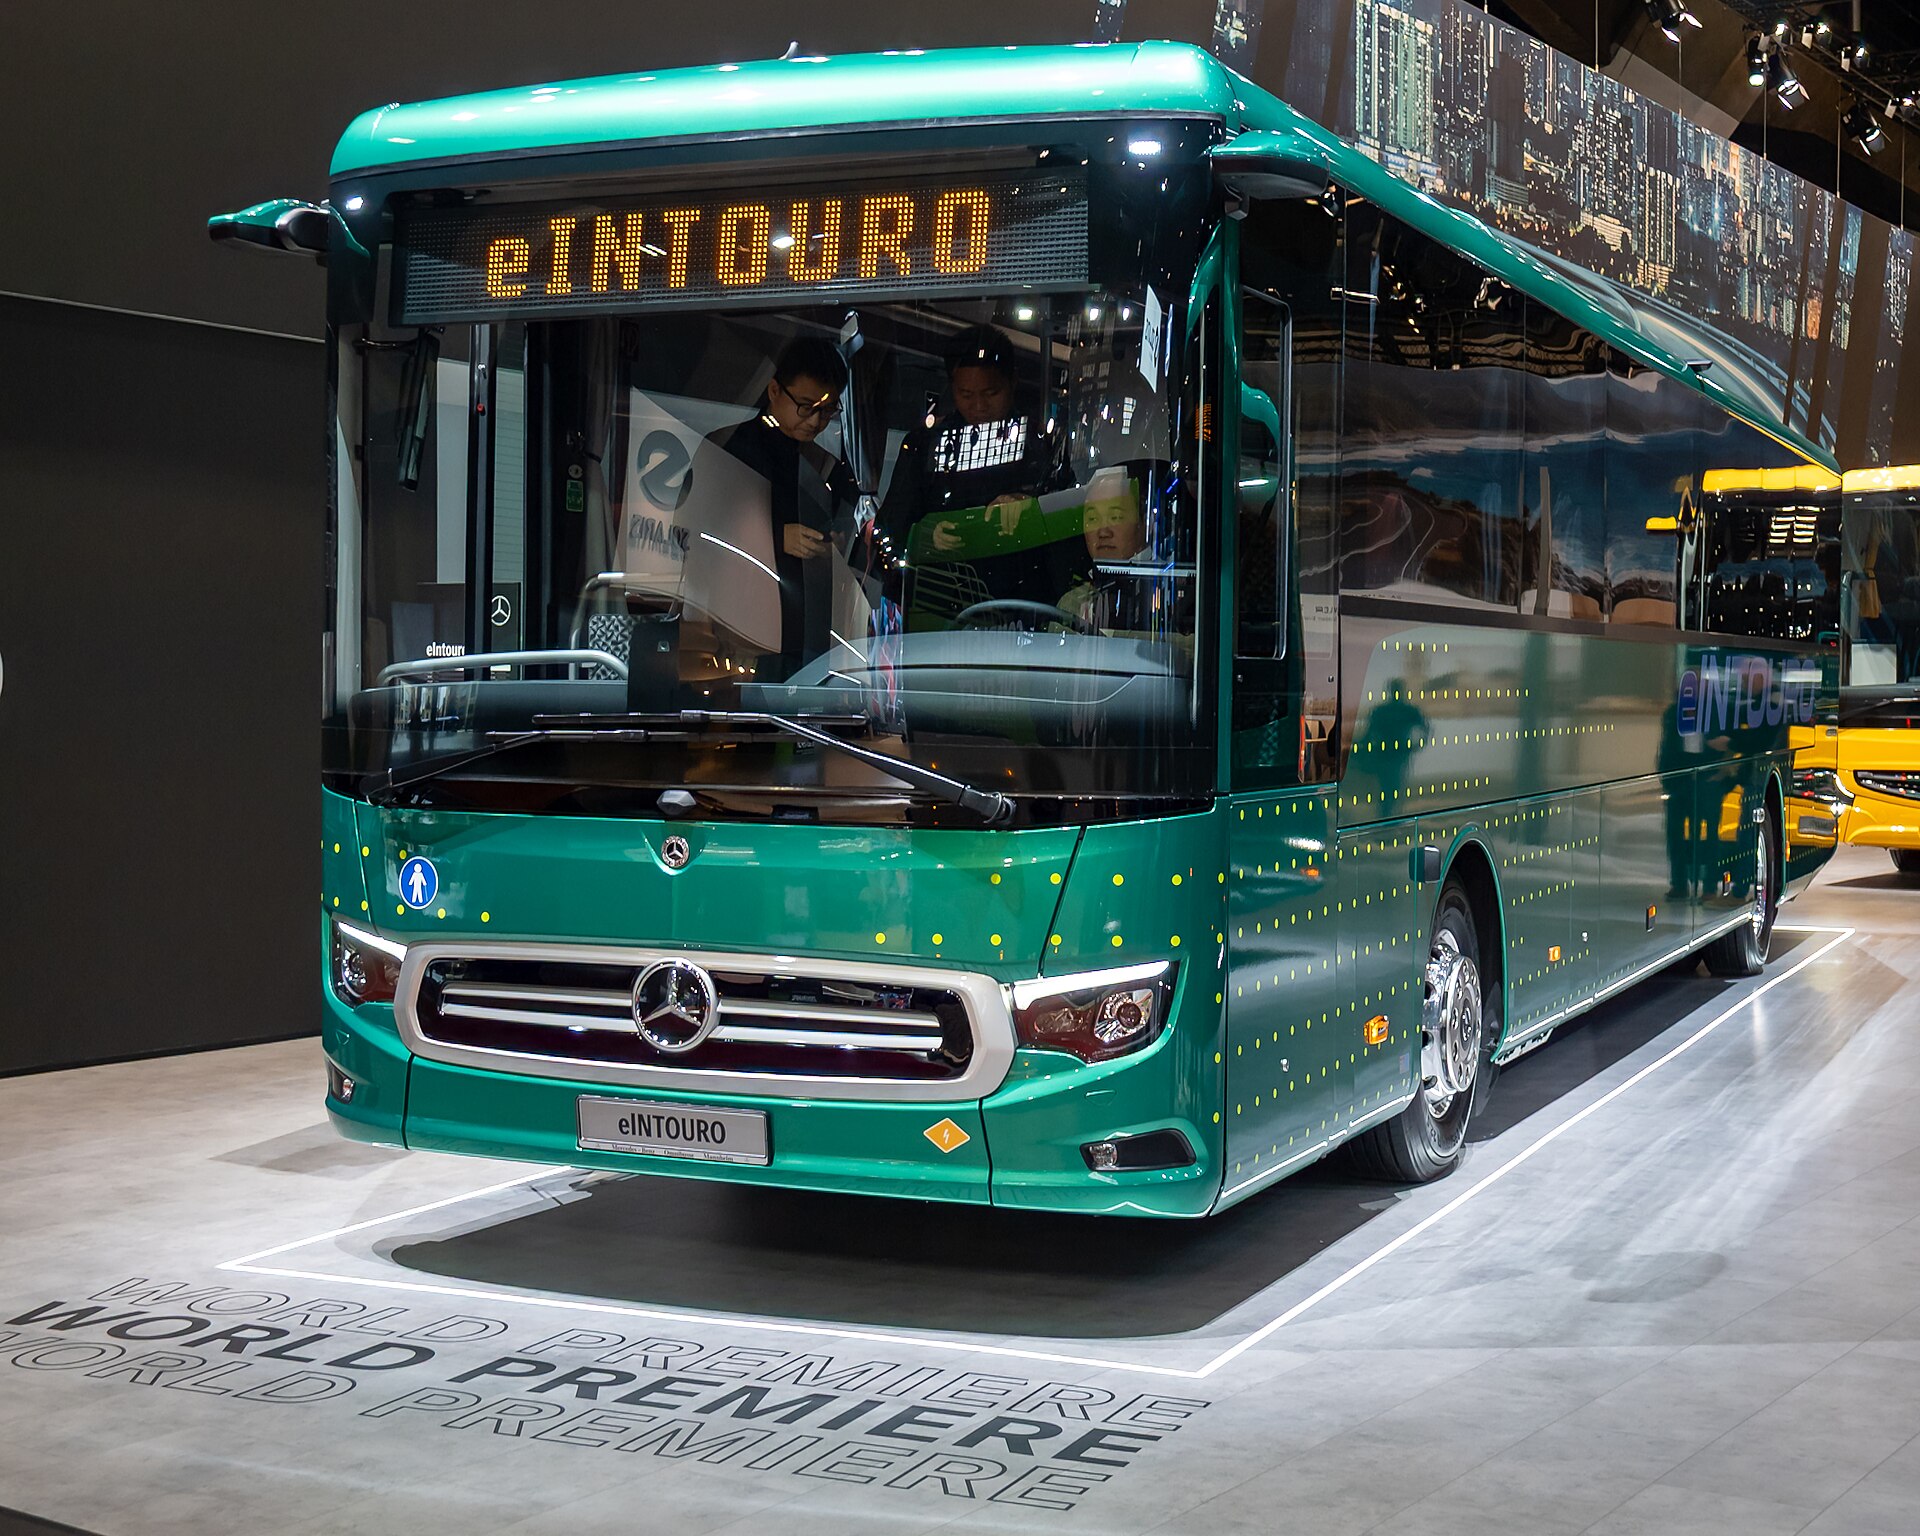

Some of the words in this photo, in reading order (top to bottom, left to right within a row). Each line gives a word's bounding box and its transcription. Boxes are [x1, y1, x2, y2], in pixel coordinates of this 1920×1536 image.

[486, 190, 990, 298] eINTOURO
[618, 1112, 726, 1144] eINTOURO
[4, 1300, 435, 1370] WORLD
[446, 1356, 1162, 1468] PREMIERE
[86, 1277, 508, 1342] WORLD
[516, 1328, 1211, 1432] PREMIERE
[358, 1386, 1114, 1511] PREMIERE
